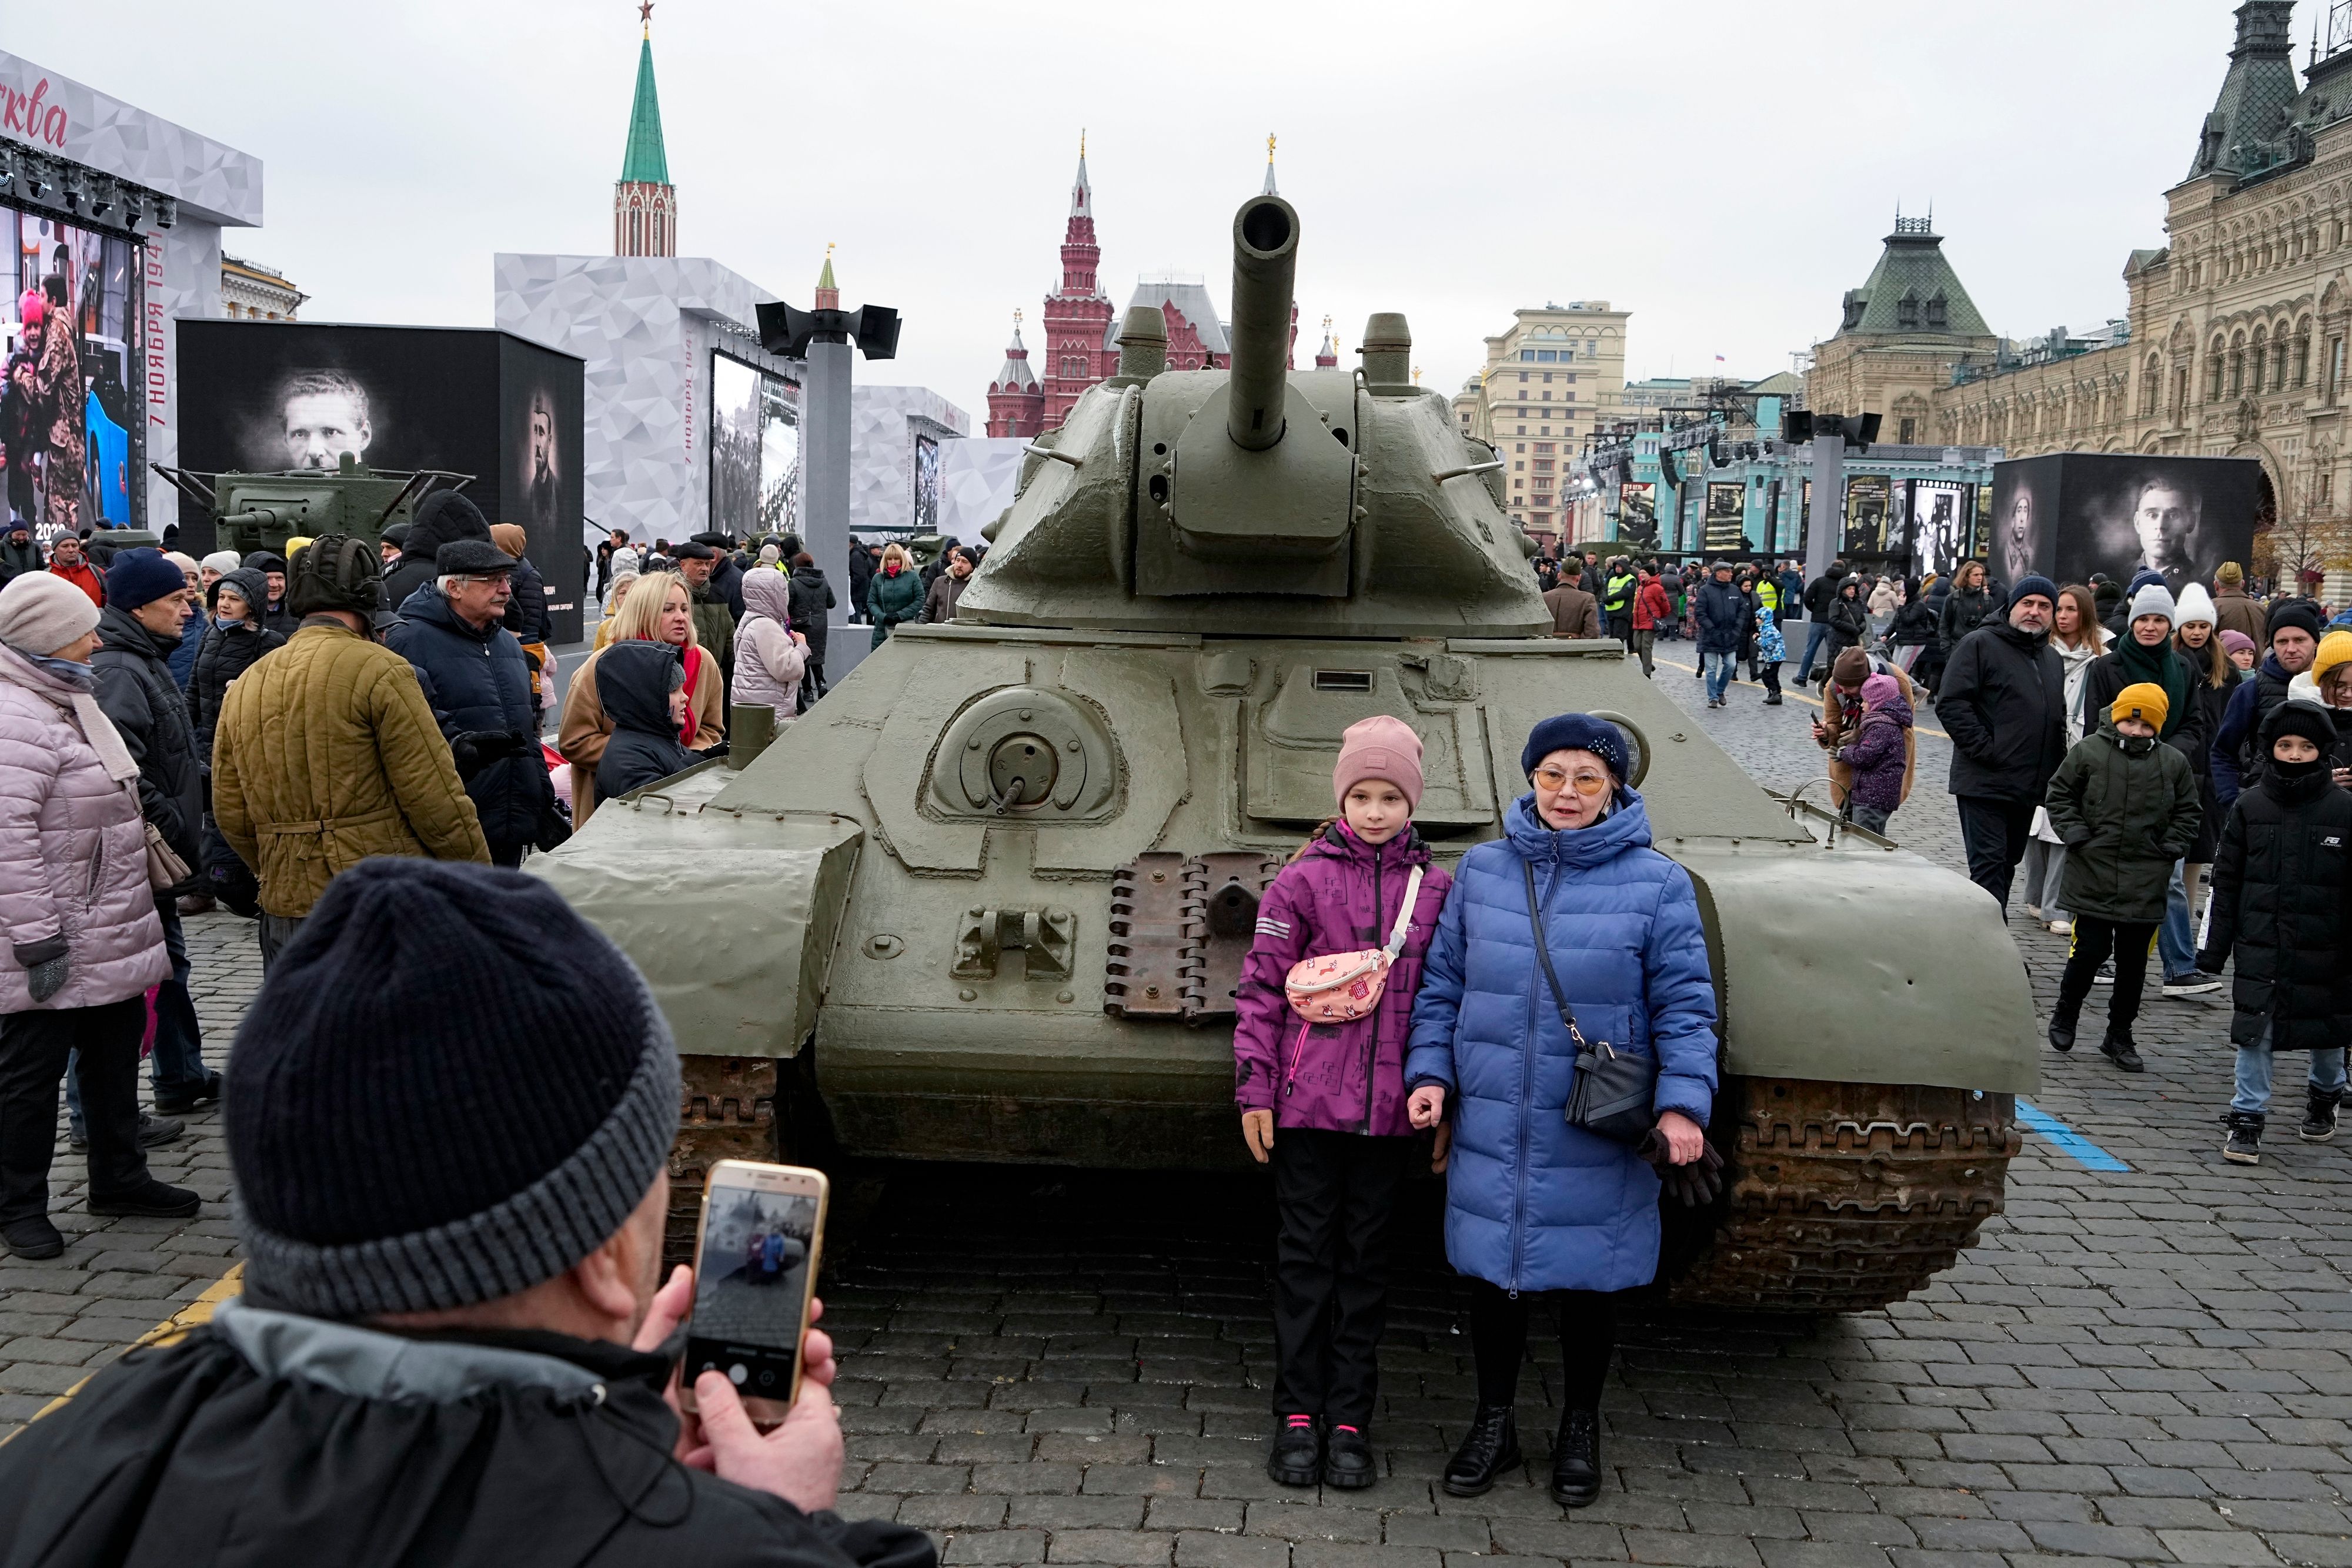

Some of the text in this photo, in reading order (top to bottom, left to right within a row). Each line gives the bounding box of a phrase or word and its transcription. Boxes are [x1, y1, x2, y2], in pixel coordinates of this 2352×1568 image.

[0, 78, 67, 148] ква
[147, 230, 165, 426] 7 НОЯБРЯ 1941
